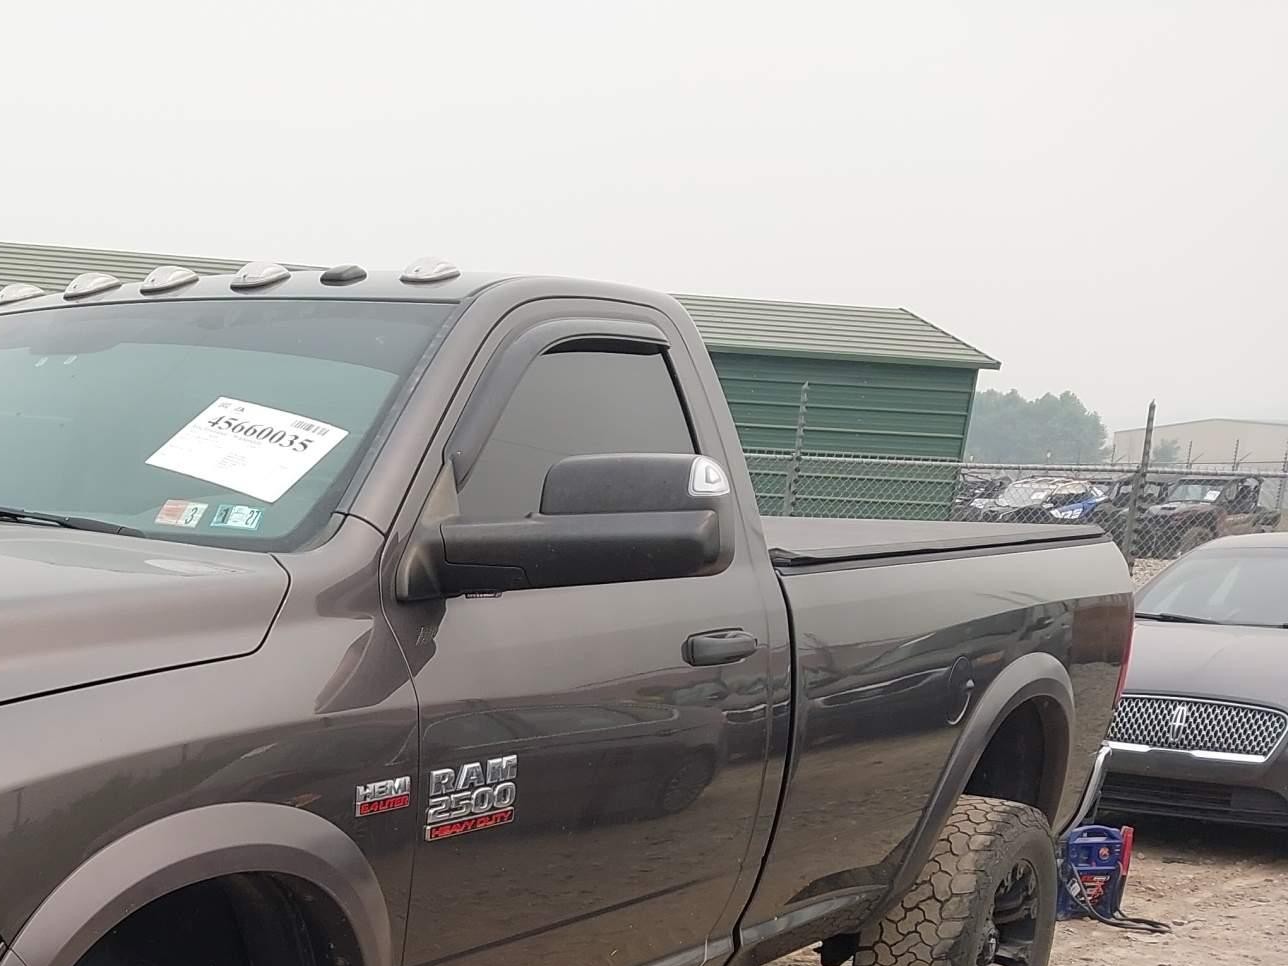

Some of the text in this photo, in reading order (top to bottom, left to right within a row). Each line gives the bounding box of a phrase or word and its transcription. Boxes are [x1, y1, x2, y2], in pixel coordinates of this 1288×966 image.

[207, 415, 314, 453] 45660035
[355, 776, 411, 802] HEMI
[429, 754, 518, 797] RAM
[427, 782, 516, 824] 2500
[431, 811, 513, 838] HEAVY DUTY
